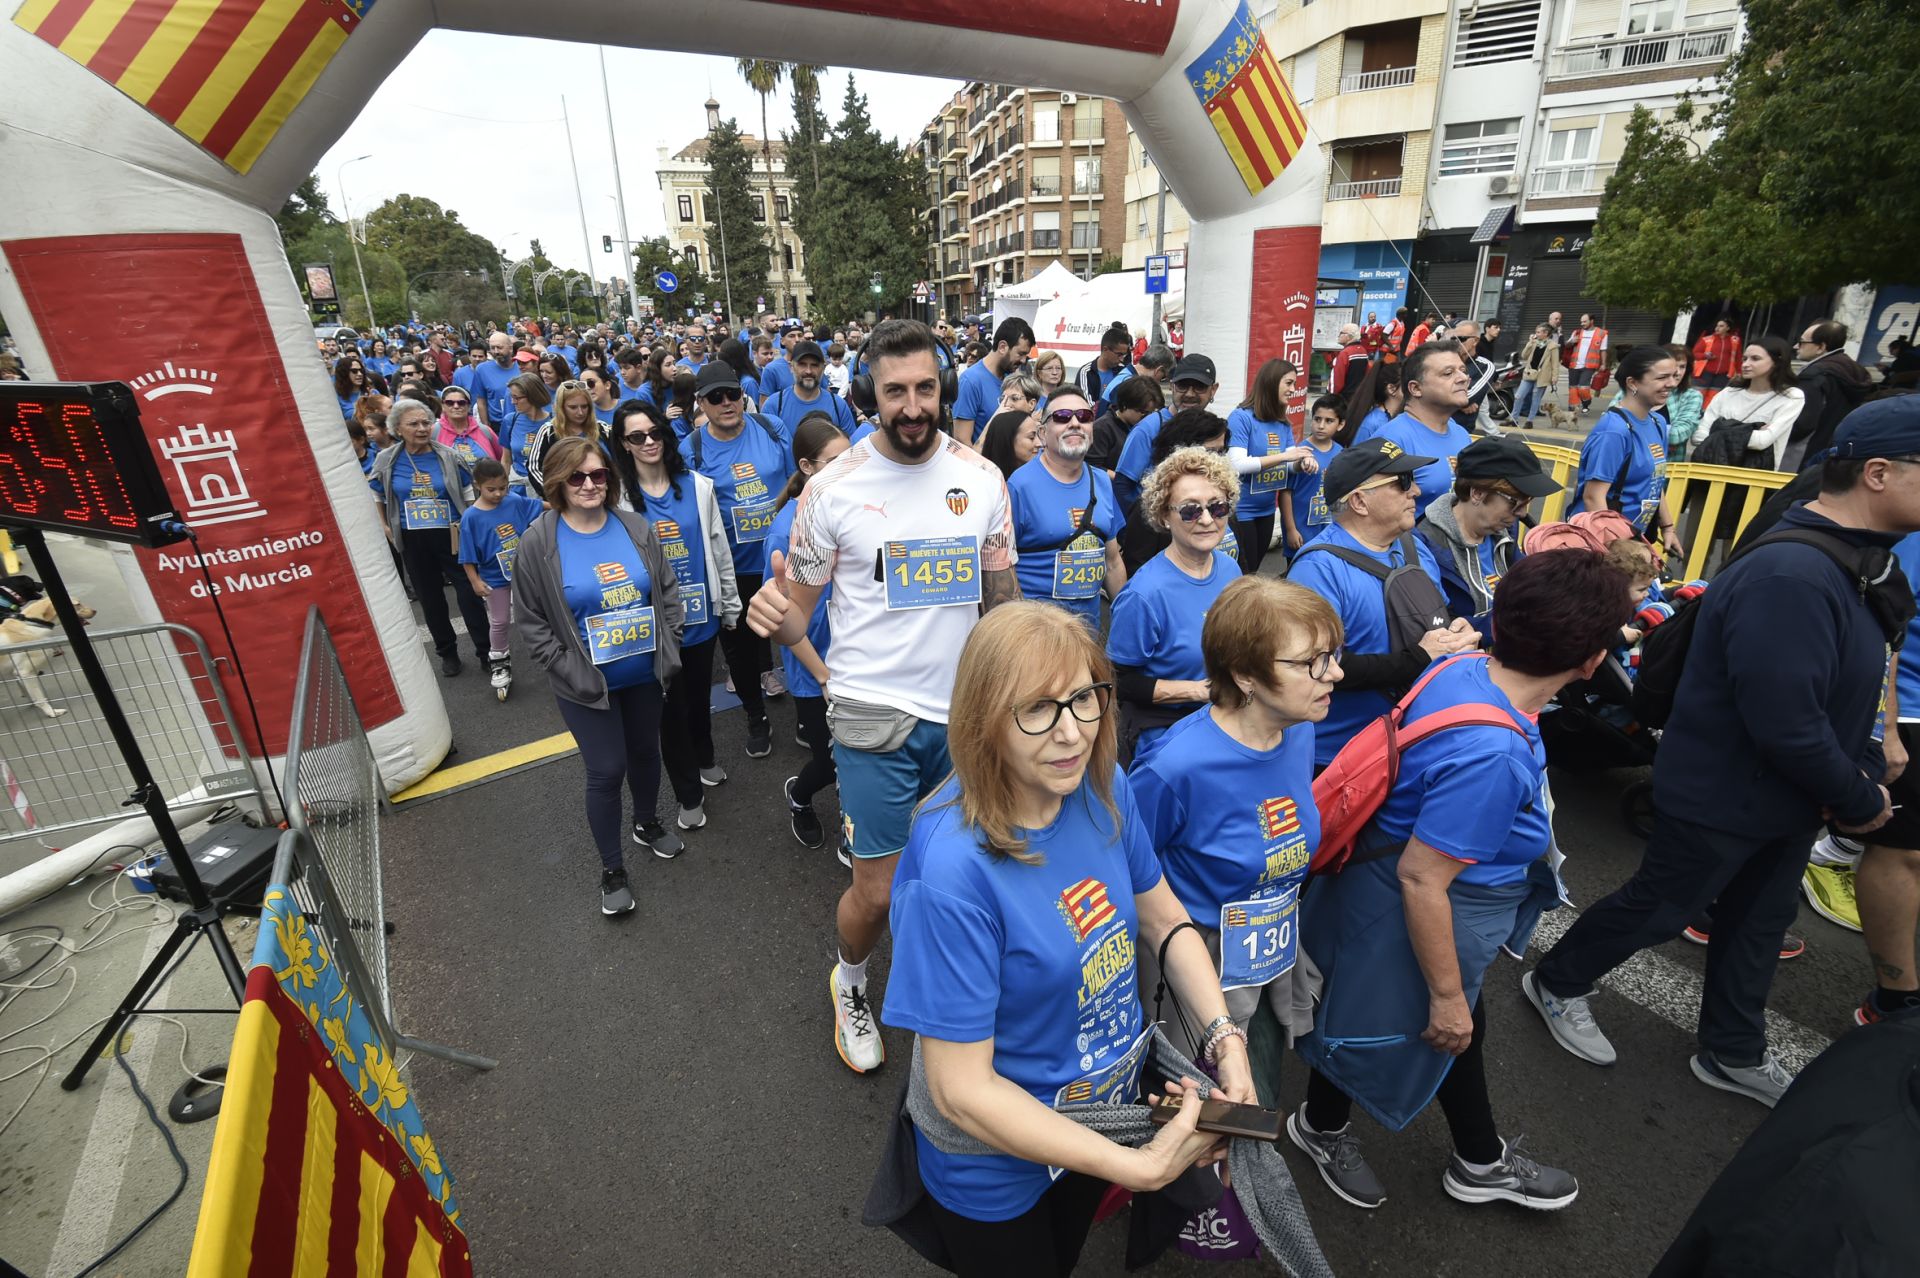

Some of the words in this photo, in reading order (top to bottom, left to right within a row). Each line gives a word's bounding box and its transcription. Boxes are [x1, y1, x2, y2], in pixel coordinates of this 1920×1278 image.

[1375, 270, 1400, 279] Roque
[1067, 323, 1081, 333] Cruz
[1082, 323, 1096, 335] Roja
[1256, 470, 1285, 483] 1920
[158, 531, 323, 574] Ayuntamiento
[190, 579, 222, 598] de
[224, 562, 313, 593] Murcia
[894, 559, 974, 587] 1455
[1061, 565, 1104, 584] 2430
[603, 583, 638, 601] MUÉVETE
[607, 591, 642, 608] VALENCIA
[596, 623, 651, 648] 2845
[1265, 840, 1307, 871] MUÉVETE
[1267, 852, 1310, 882] VALENCIA
[1249, 911, 1280, 927] MUÉVETE
[1242, 919, 1291, 960] 130
[1082, 927, 1130, 985] MUÉVETE
[1077, 986, 1087, 1008] X
